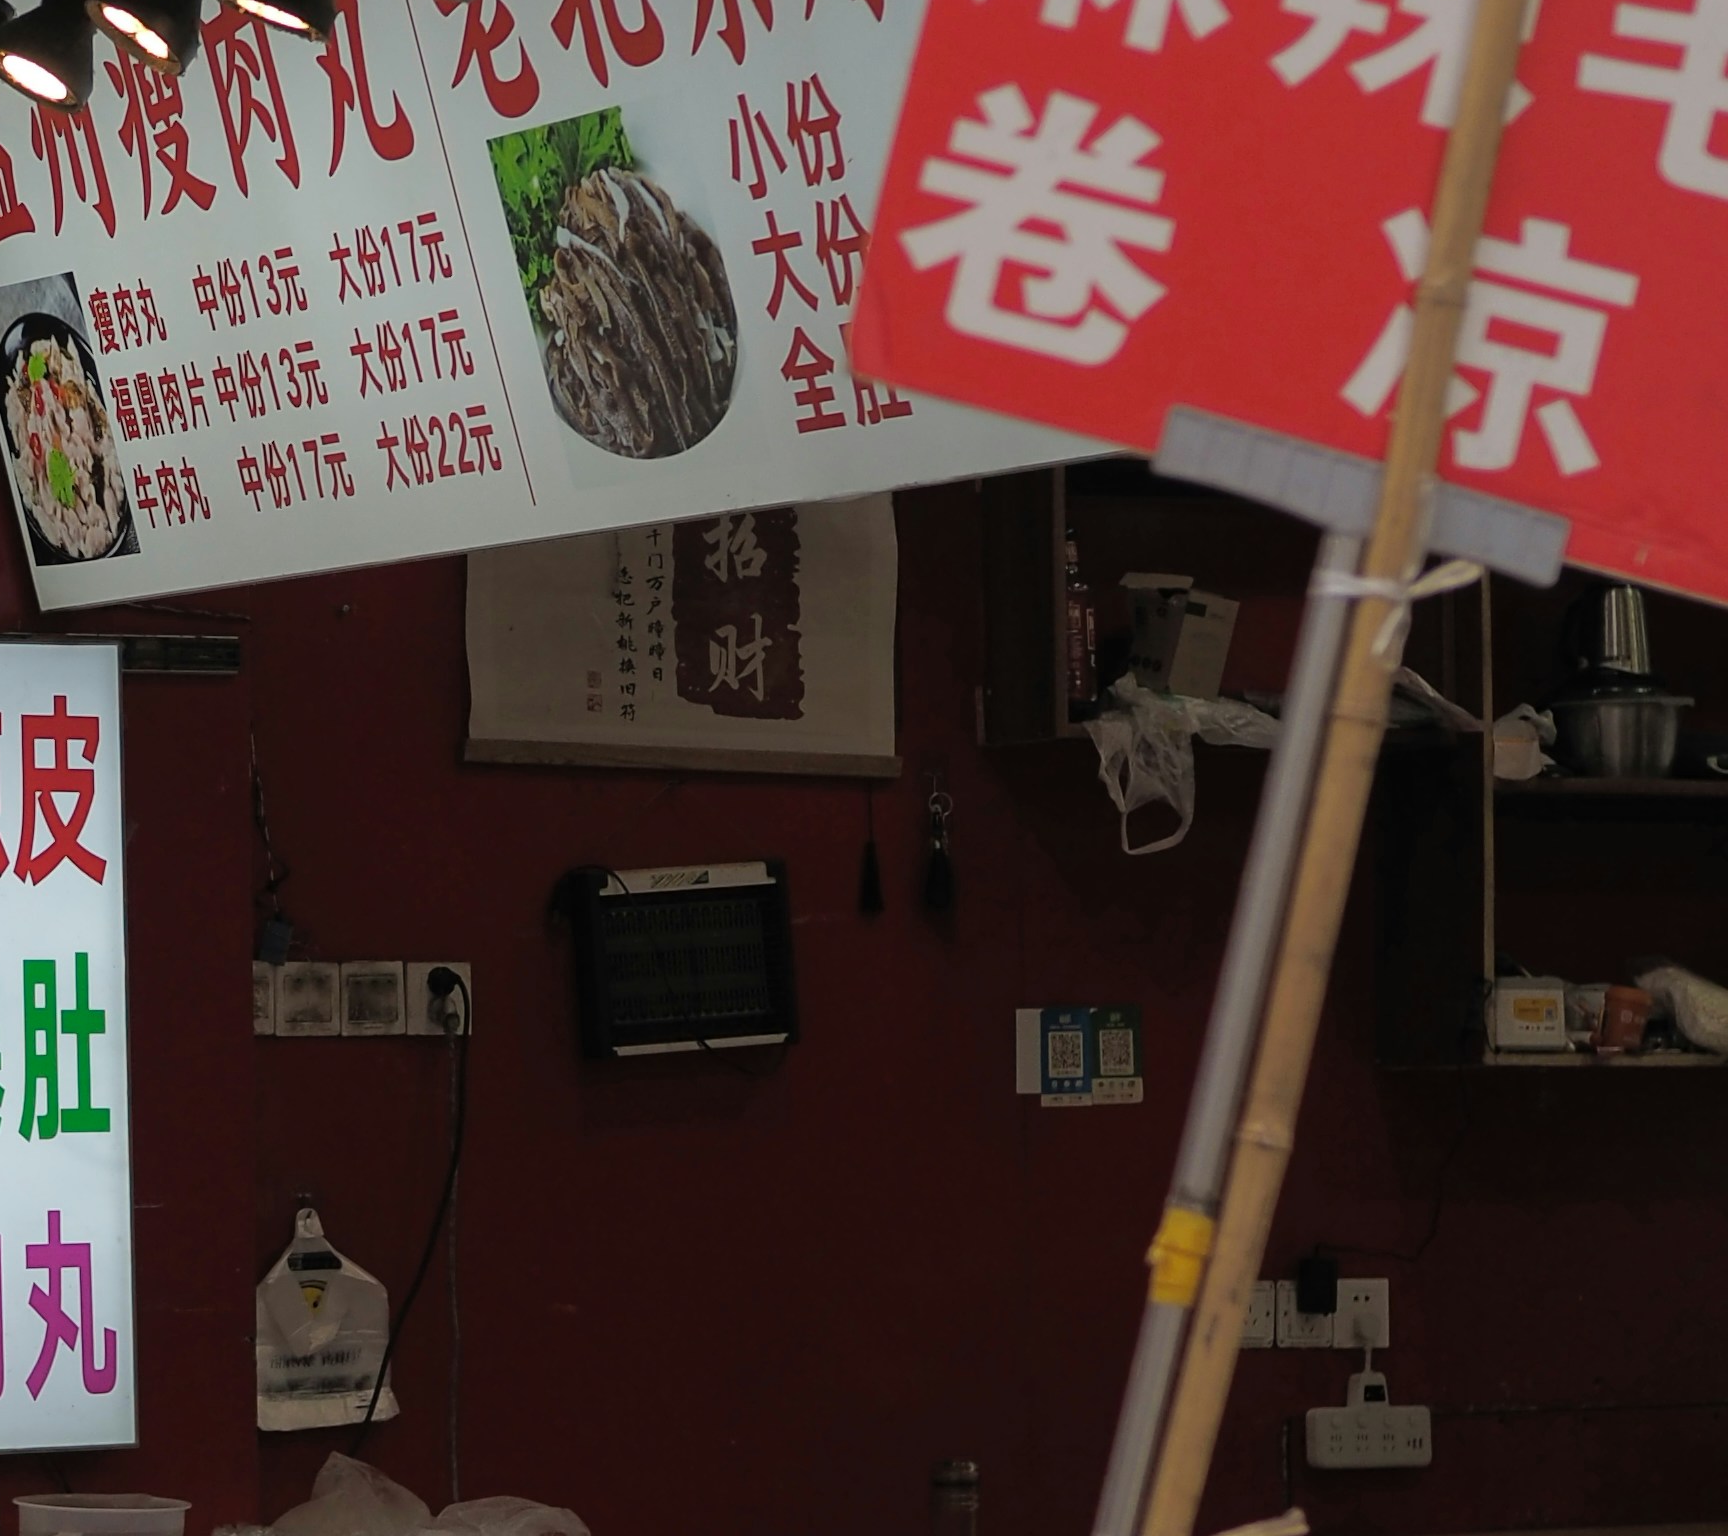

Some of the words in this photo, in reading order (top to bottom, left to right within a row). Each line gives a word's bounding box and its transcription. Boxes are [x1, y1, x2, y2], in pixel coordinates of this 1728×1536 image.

[87, 277, 169, 356] 瘦肉丸
[191, 246, 309, 333] 中份13元
[328, 210, 455, 306] 大份17元
[899, 83, 1178, 368] 卷
[110, 360, 212, 443] 福鼎肉片
[213, 340, 331, 424] 中份13元
[349, 307, 476, 401] 大份17元
[132, 456, 213, 530] 牛肉丸
[236, 431, 356, 514] 中份17元
[376, 403, 504, 494] 大份22元
